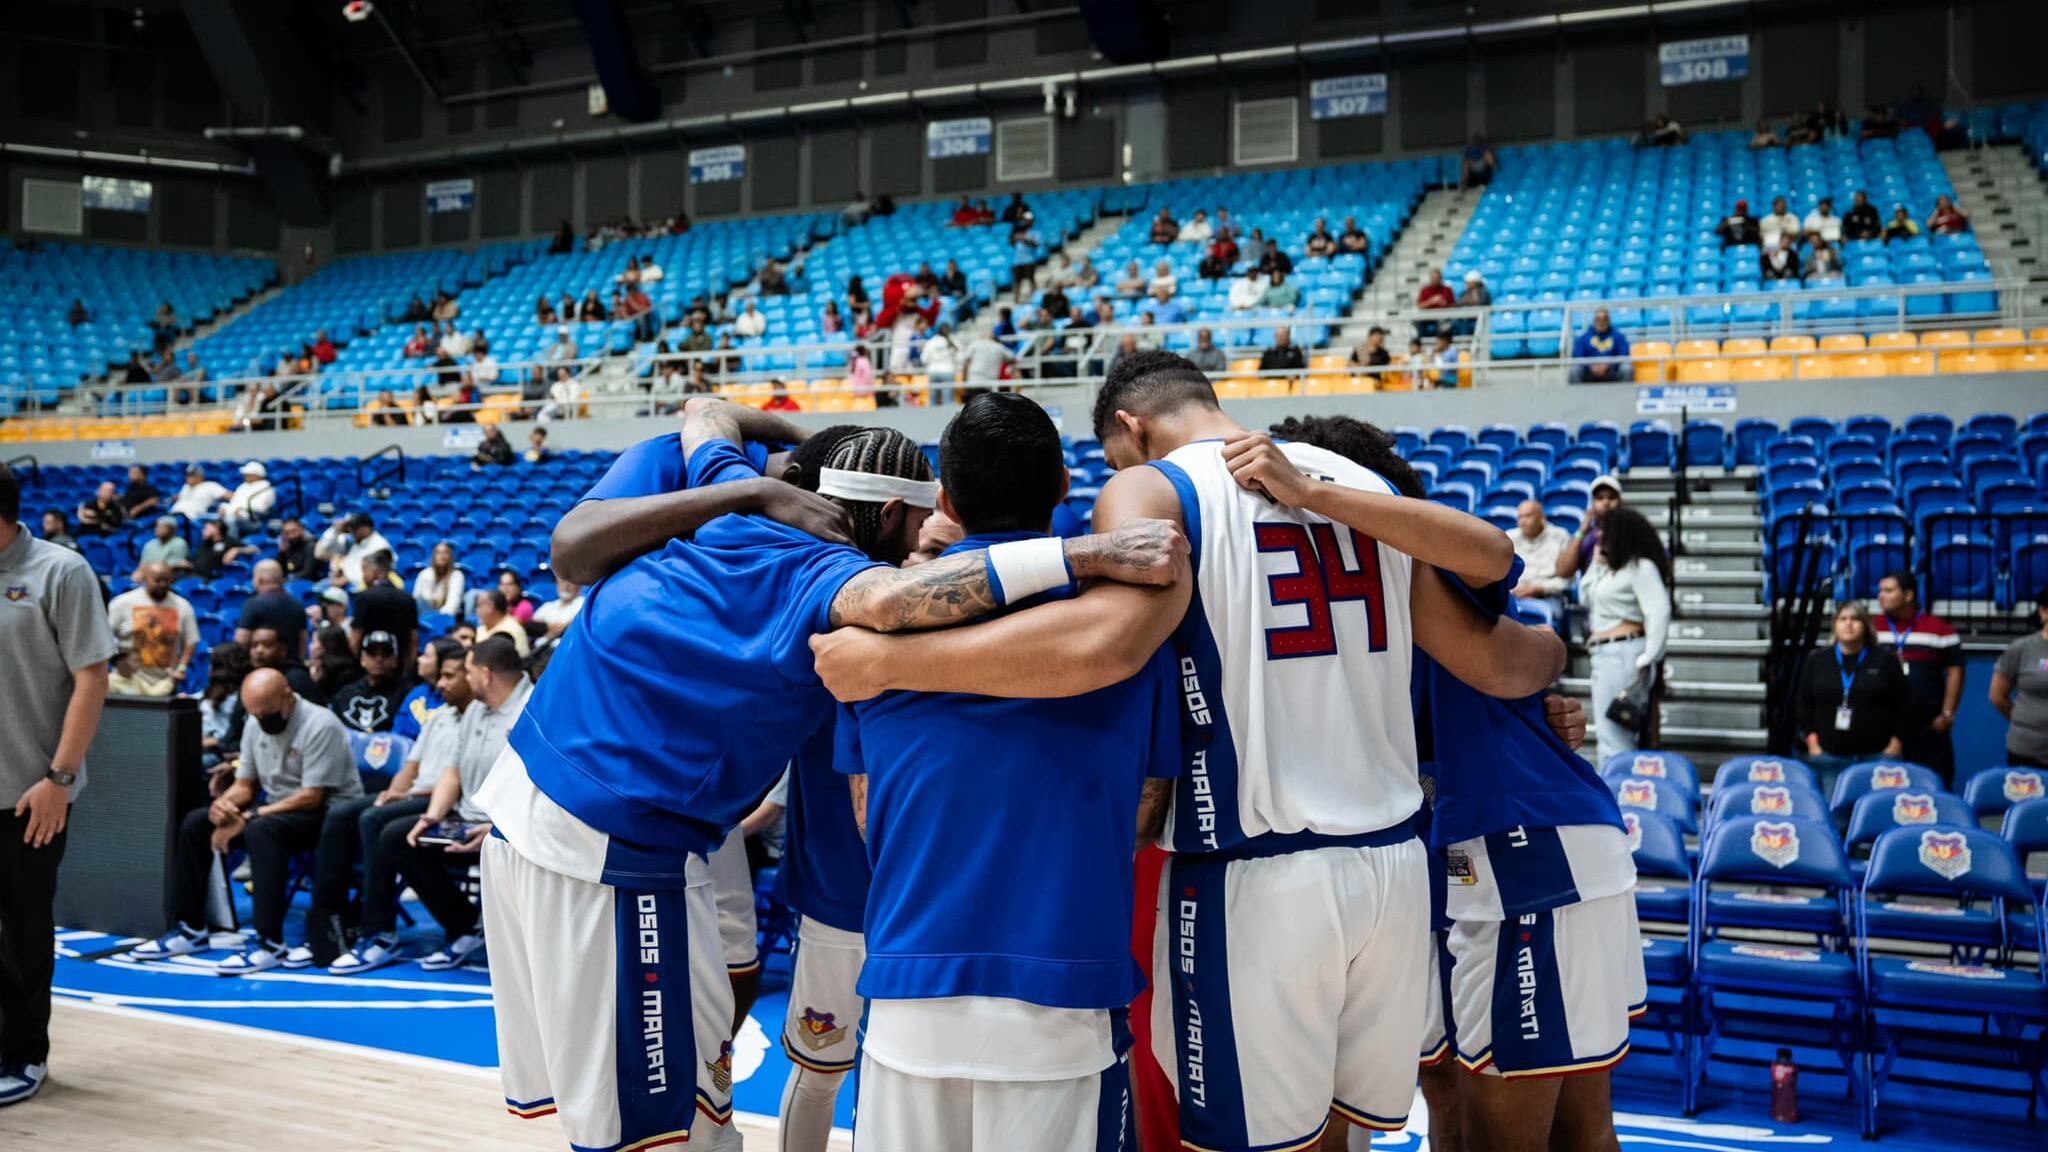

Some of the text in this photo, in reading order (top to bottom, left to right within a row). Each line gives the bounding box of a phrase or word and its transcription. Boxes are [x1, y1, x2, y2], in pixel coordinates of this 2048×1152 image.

[1328, 95, 1369, 117] 307
[1680, 59, 1729, 82] 308
[1253, 521, 1387, 660] 34
[1181, 656, 1220, 850] OSOS MANAT
[637, 894, 668, 1095] OSOS MANATI
[1180, 900, 1206, 1109] OSOS MANATI
[1518, 946, 1540, 1040] MANATI
